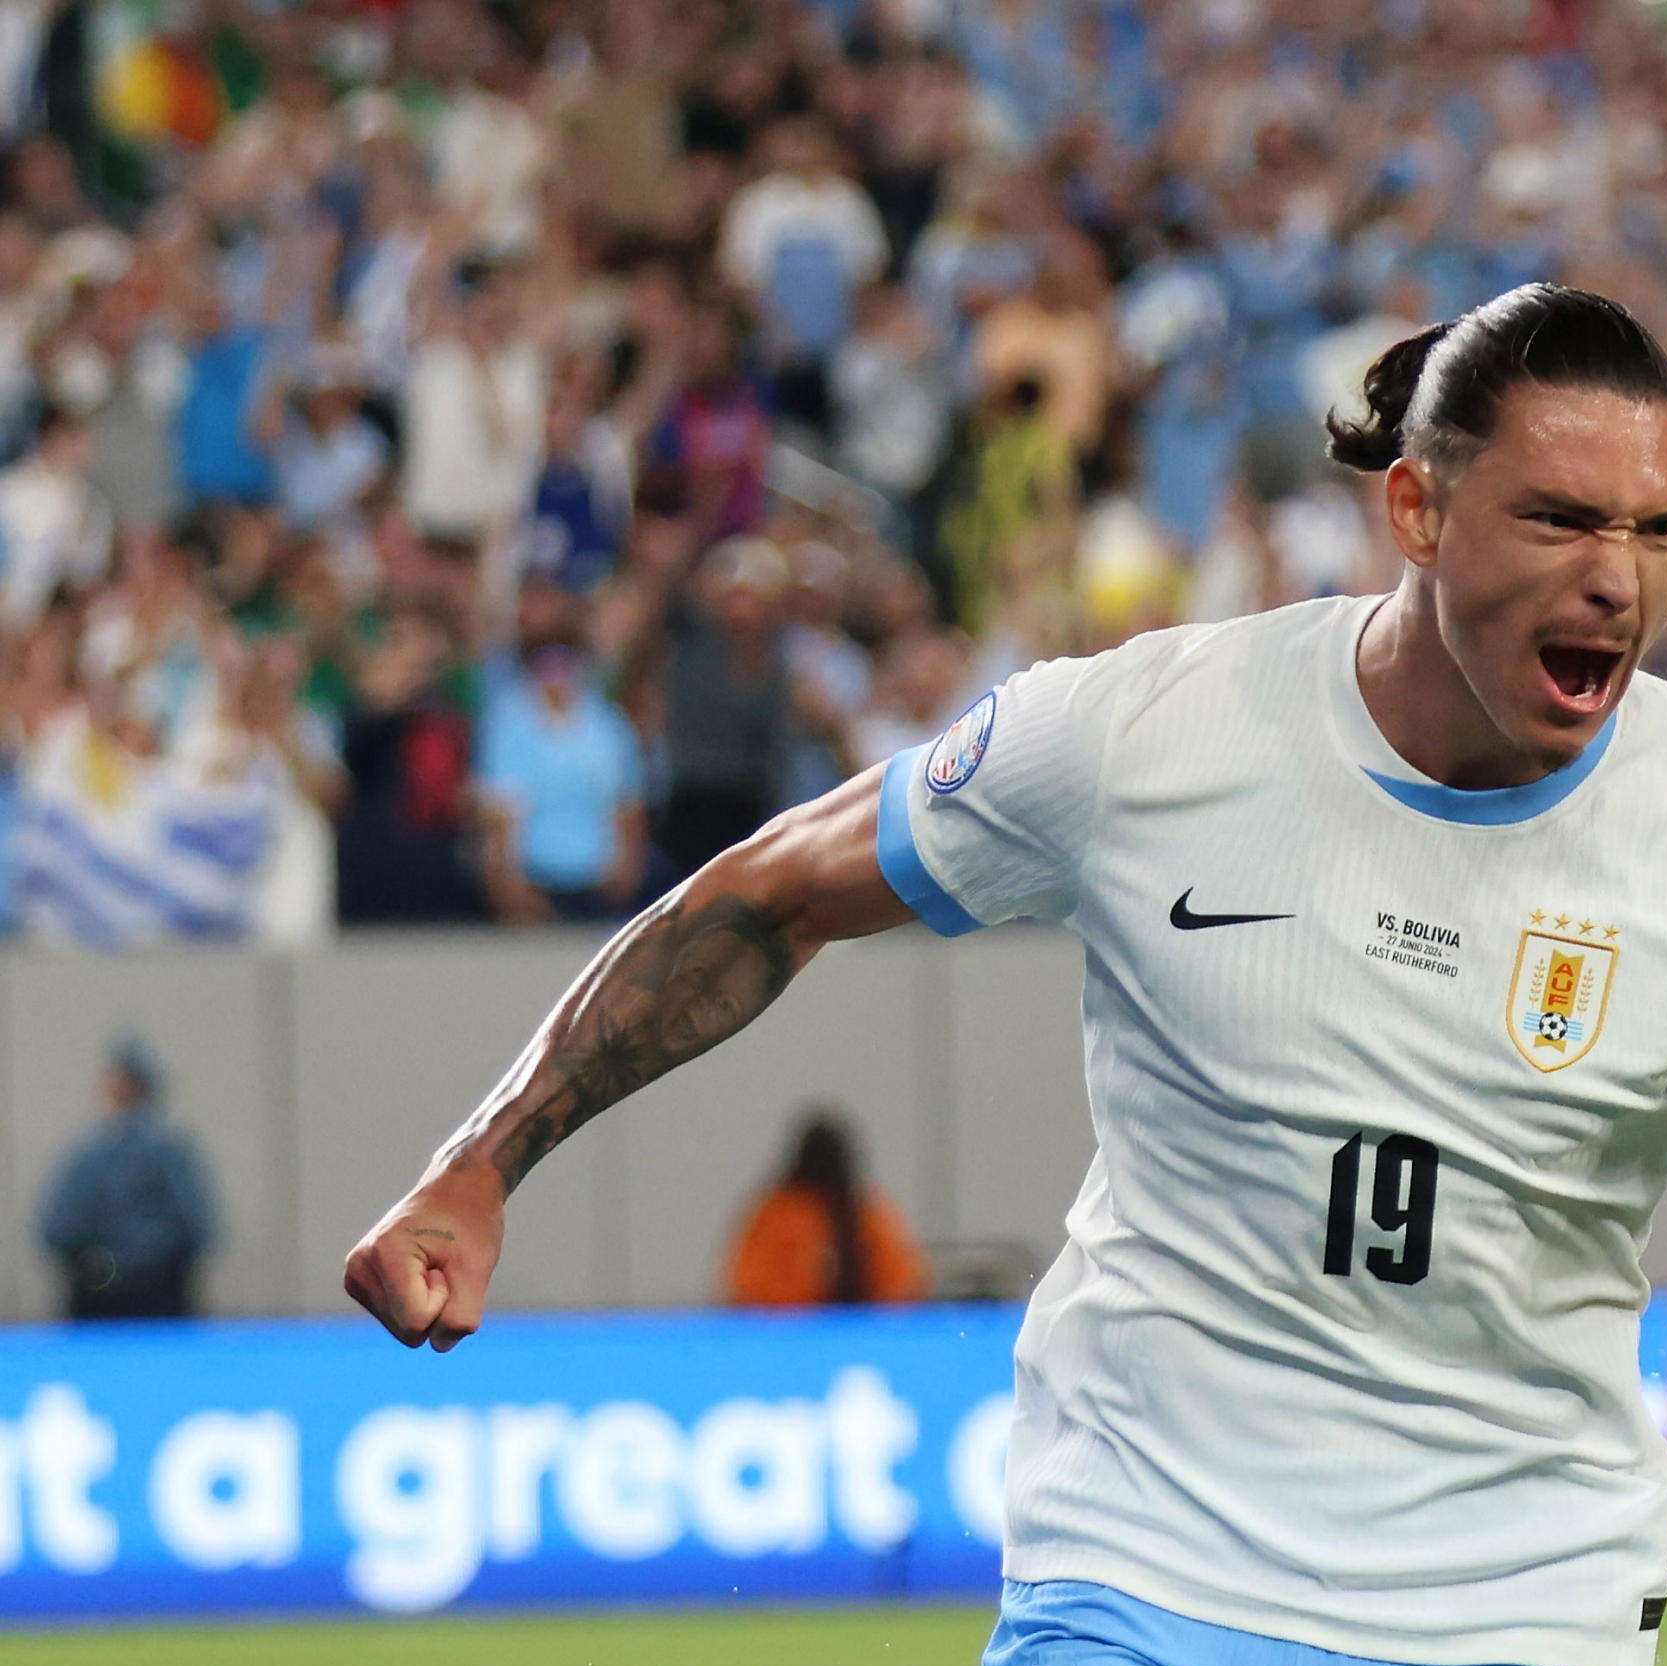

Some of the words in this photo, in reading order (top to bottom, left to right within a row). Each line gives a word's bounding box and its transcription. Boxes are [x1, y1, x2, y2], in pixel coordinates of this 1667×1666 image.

[1377, 911, 1399, 932] VS.
[1402, 919, 1461, 949] BOLIVIA
[1399, 938, 1423, 953] JUNIO
[1423, 943, 1444, 958] 2024
[1365, 943, 1391, 961] EAST
[1391, 950, 1459, 978] RUTHERFORD
[1547, 962, 1574, 1006] AUF
[1322, 1130, 1440, 1286] 19
[0, 1382, 118, 1574] t
[150, 1406, 303, 1570] a
[334, 1366, 918, 1613] great
